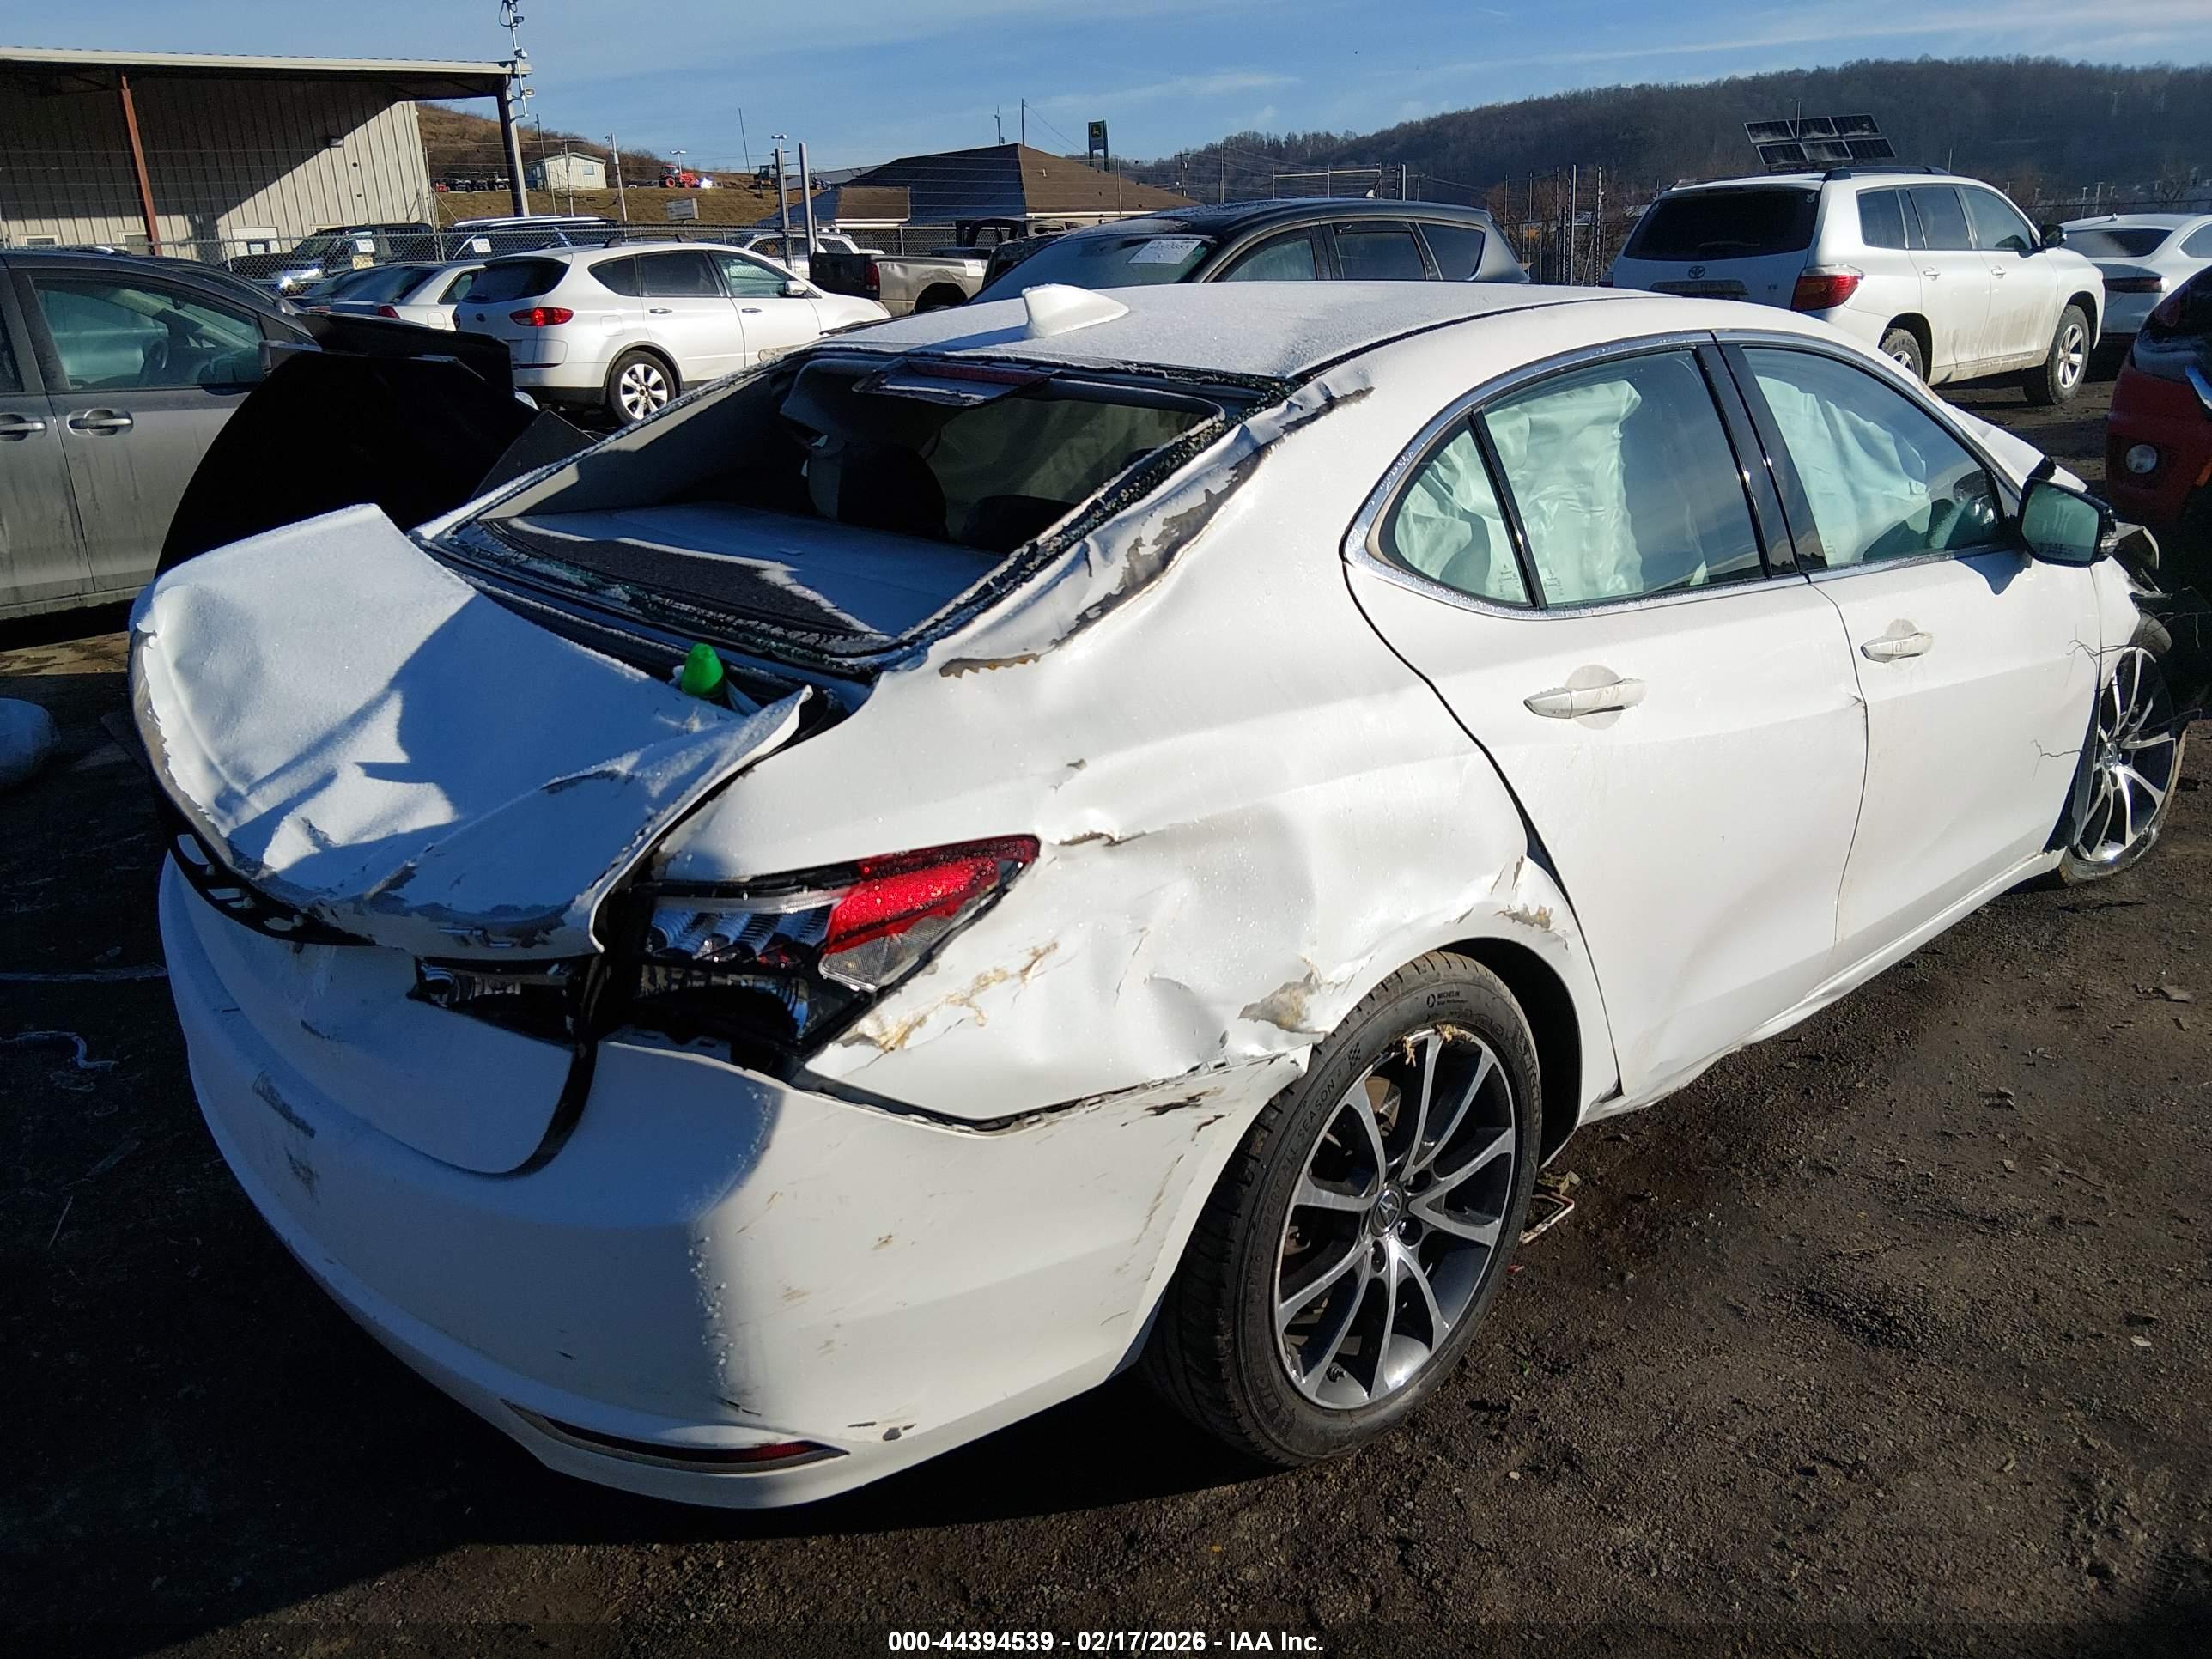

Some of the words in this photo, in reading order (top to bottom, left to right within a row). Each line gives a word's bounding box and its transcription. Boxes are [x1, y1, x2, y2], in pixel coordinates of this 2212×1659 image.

[1261, 1180, 1284, 1236] SPORT
[1283, 1146, 1299, 1176] ALL
[1297, 1081, 1334, 1140] SEASON
